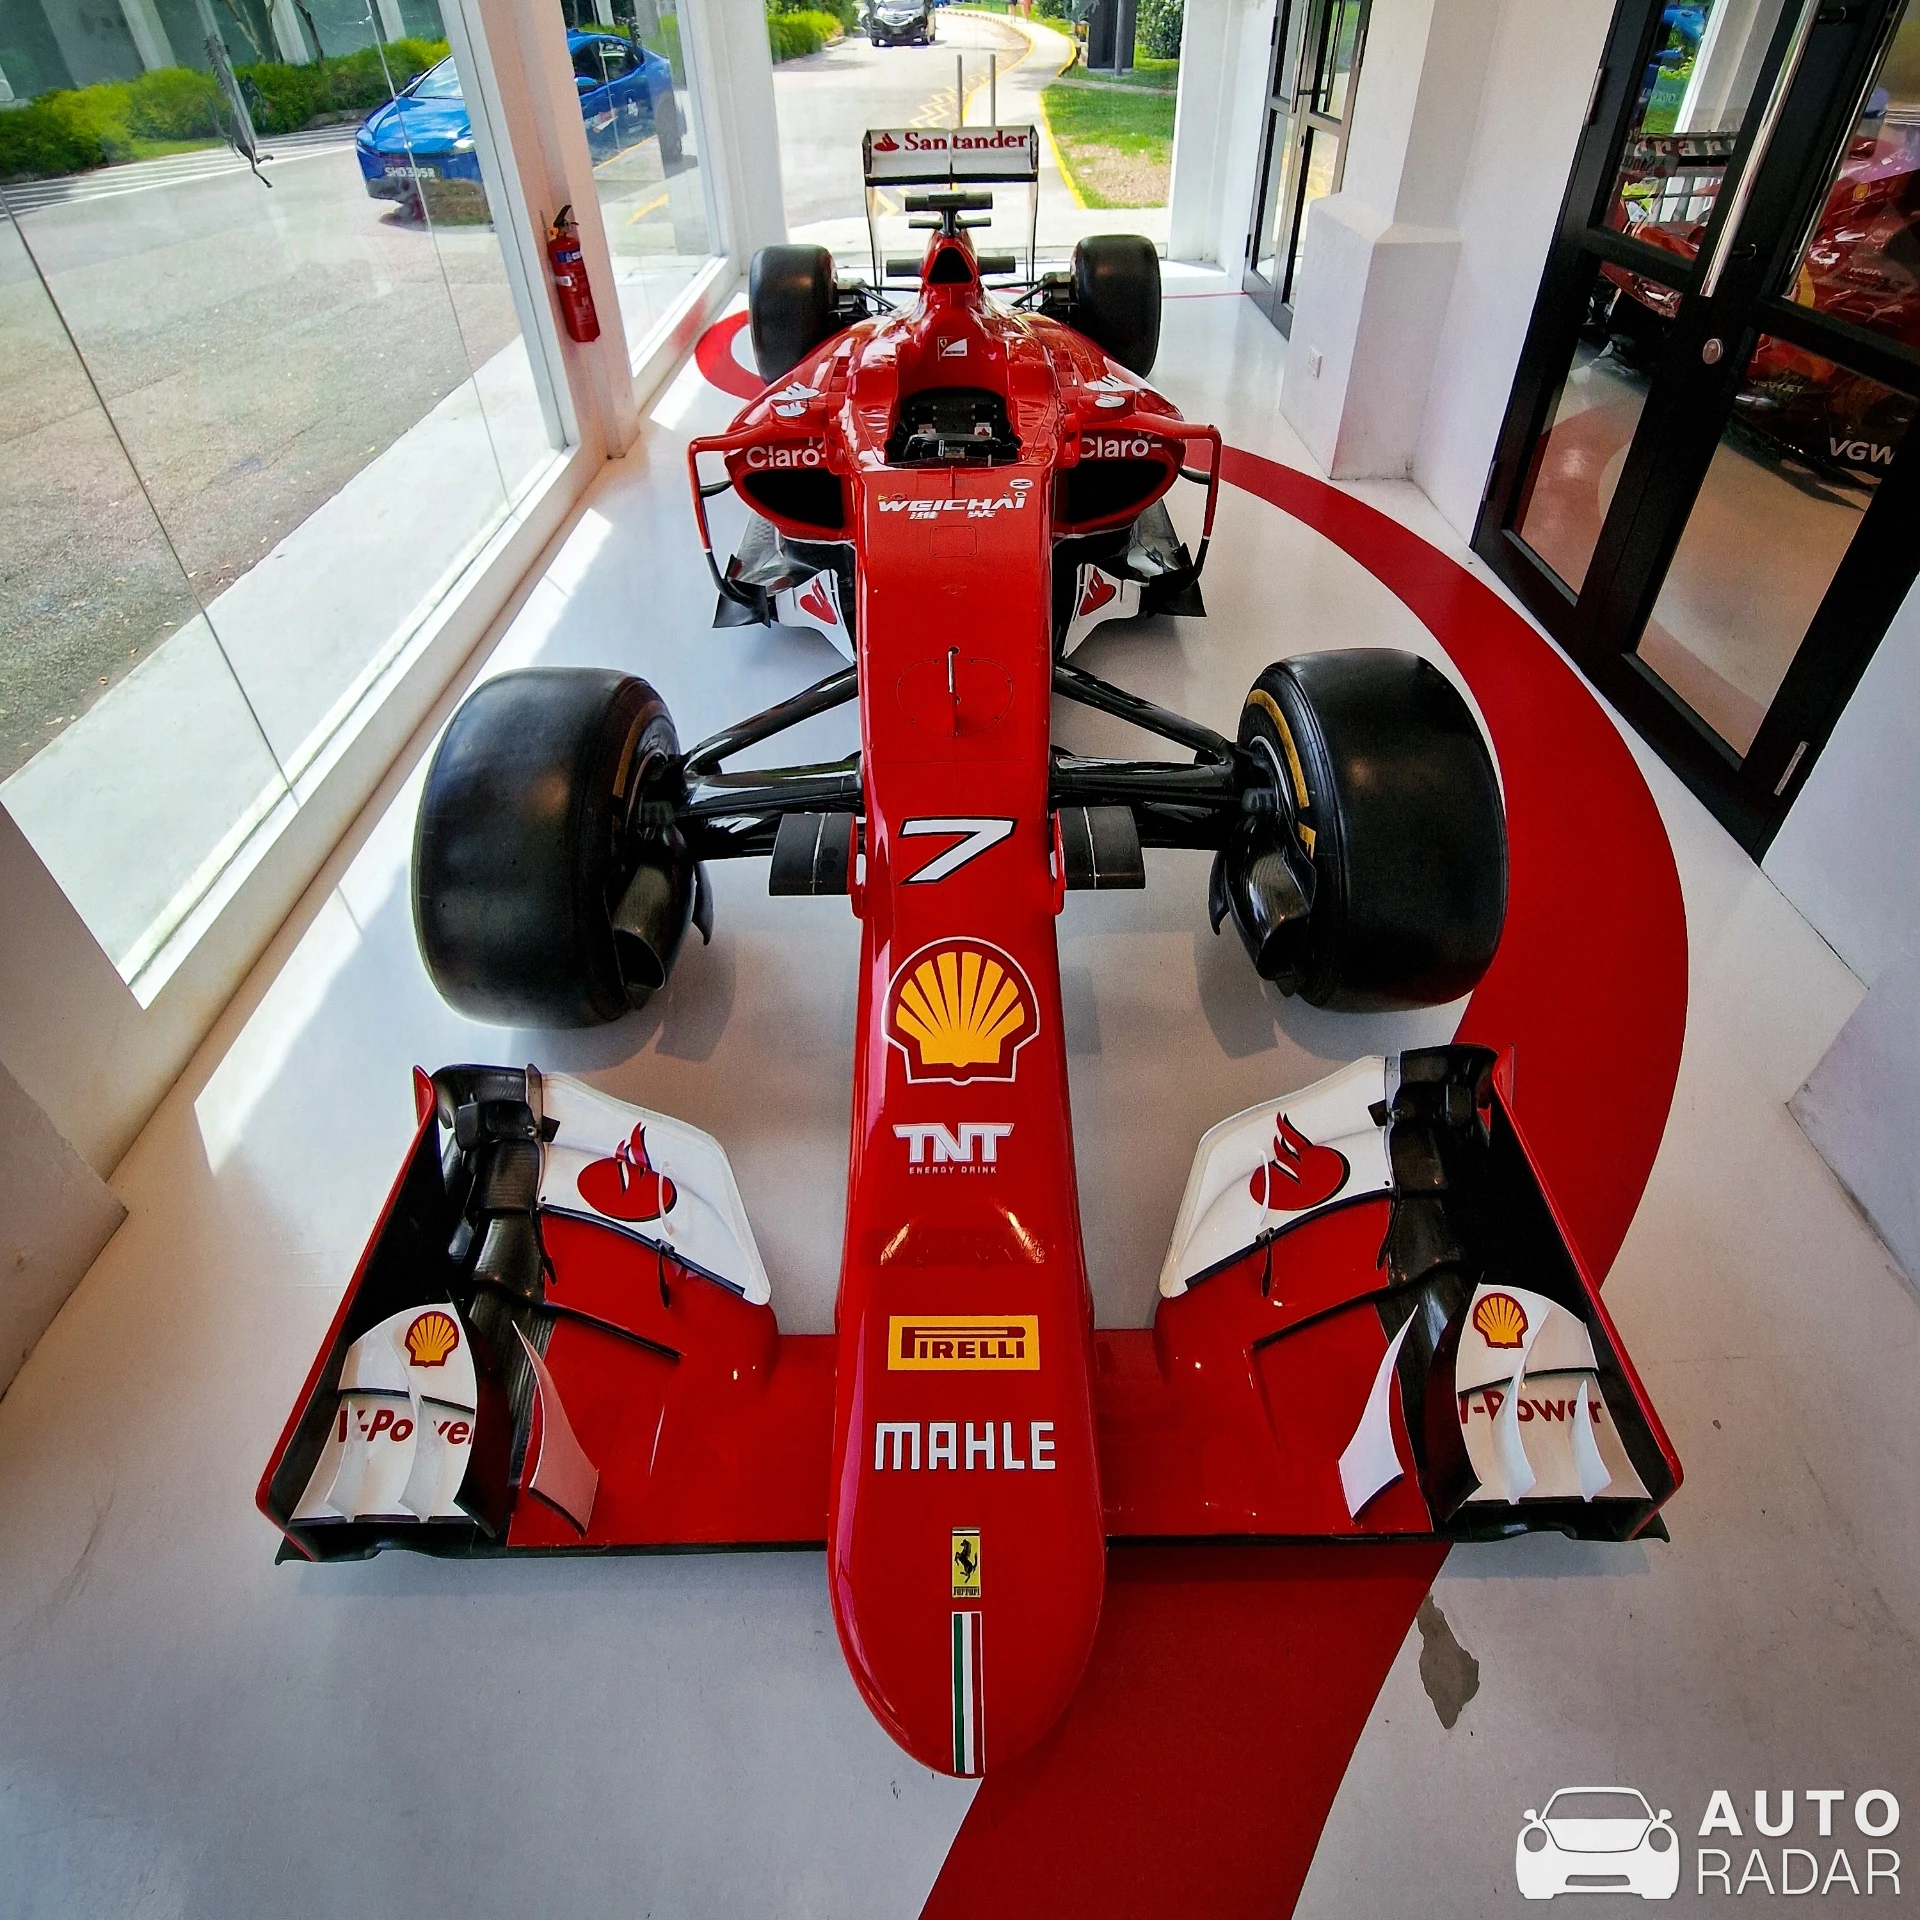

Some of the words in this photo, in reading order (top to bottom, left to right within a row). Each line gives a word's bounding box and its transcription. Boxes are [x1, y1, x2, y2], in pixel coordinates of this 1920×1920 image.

[905, 130, 1028, 151] Santander
[746, 443, 821, 468] Claro
[1080, 435, 1150, 459] Claro
[1829, 437, 1896, 465] VGW
[878, 497, 1027, 512] WEICHAI
[898, 816, 1018, 886] 7
[892, 1122, 1015, 1163] TNT
[909, 1165, 955, 1175] ENERGY
[961, 1165, 998, 1175] DRINK
[900, 1326, 1027, 1359] PIRELLI
[874, 1421, 1057, 1470] MAHLE
